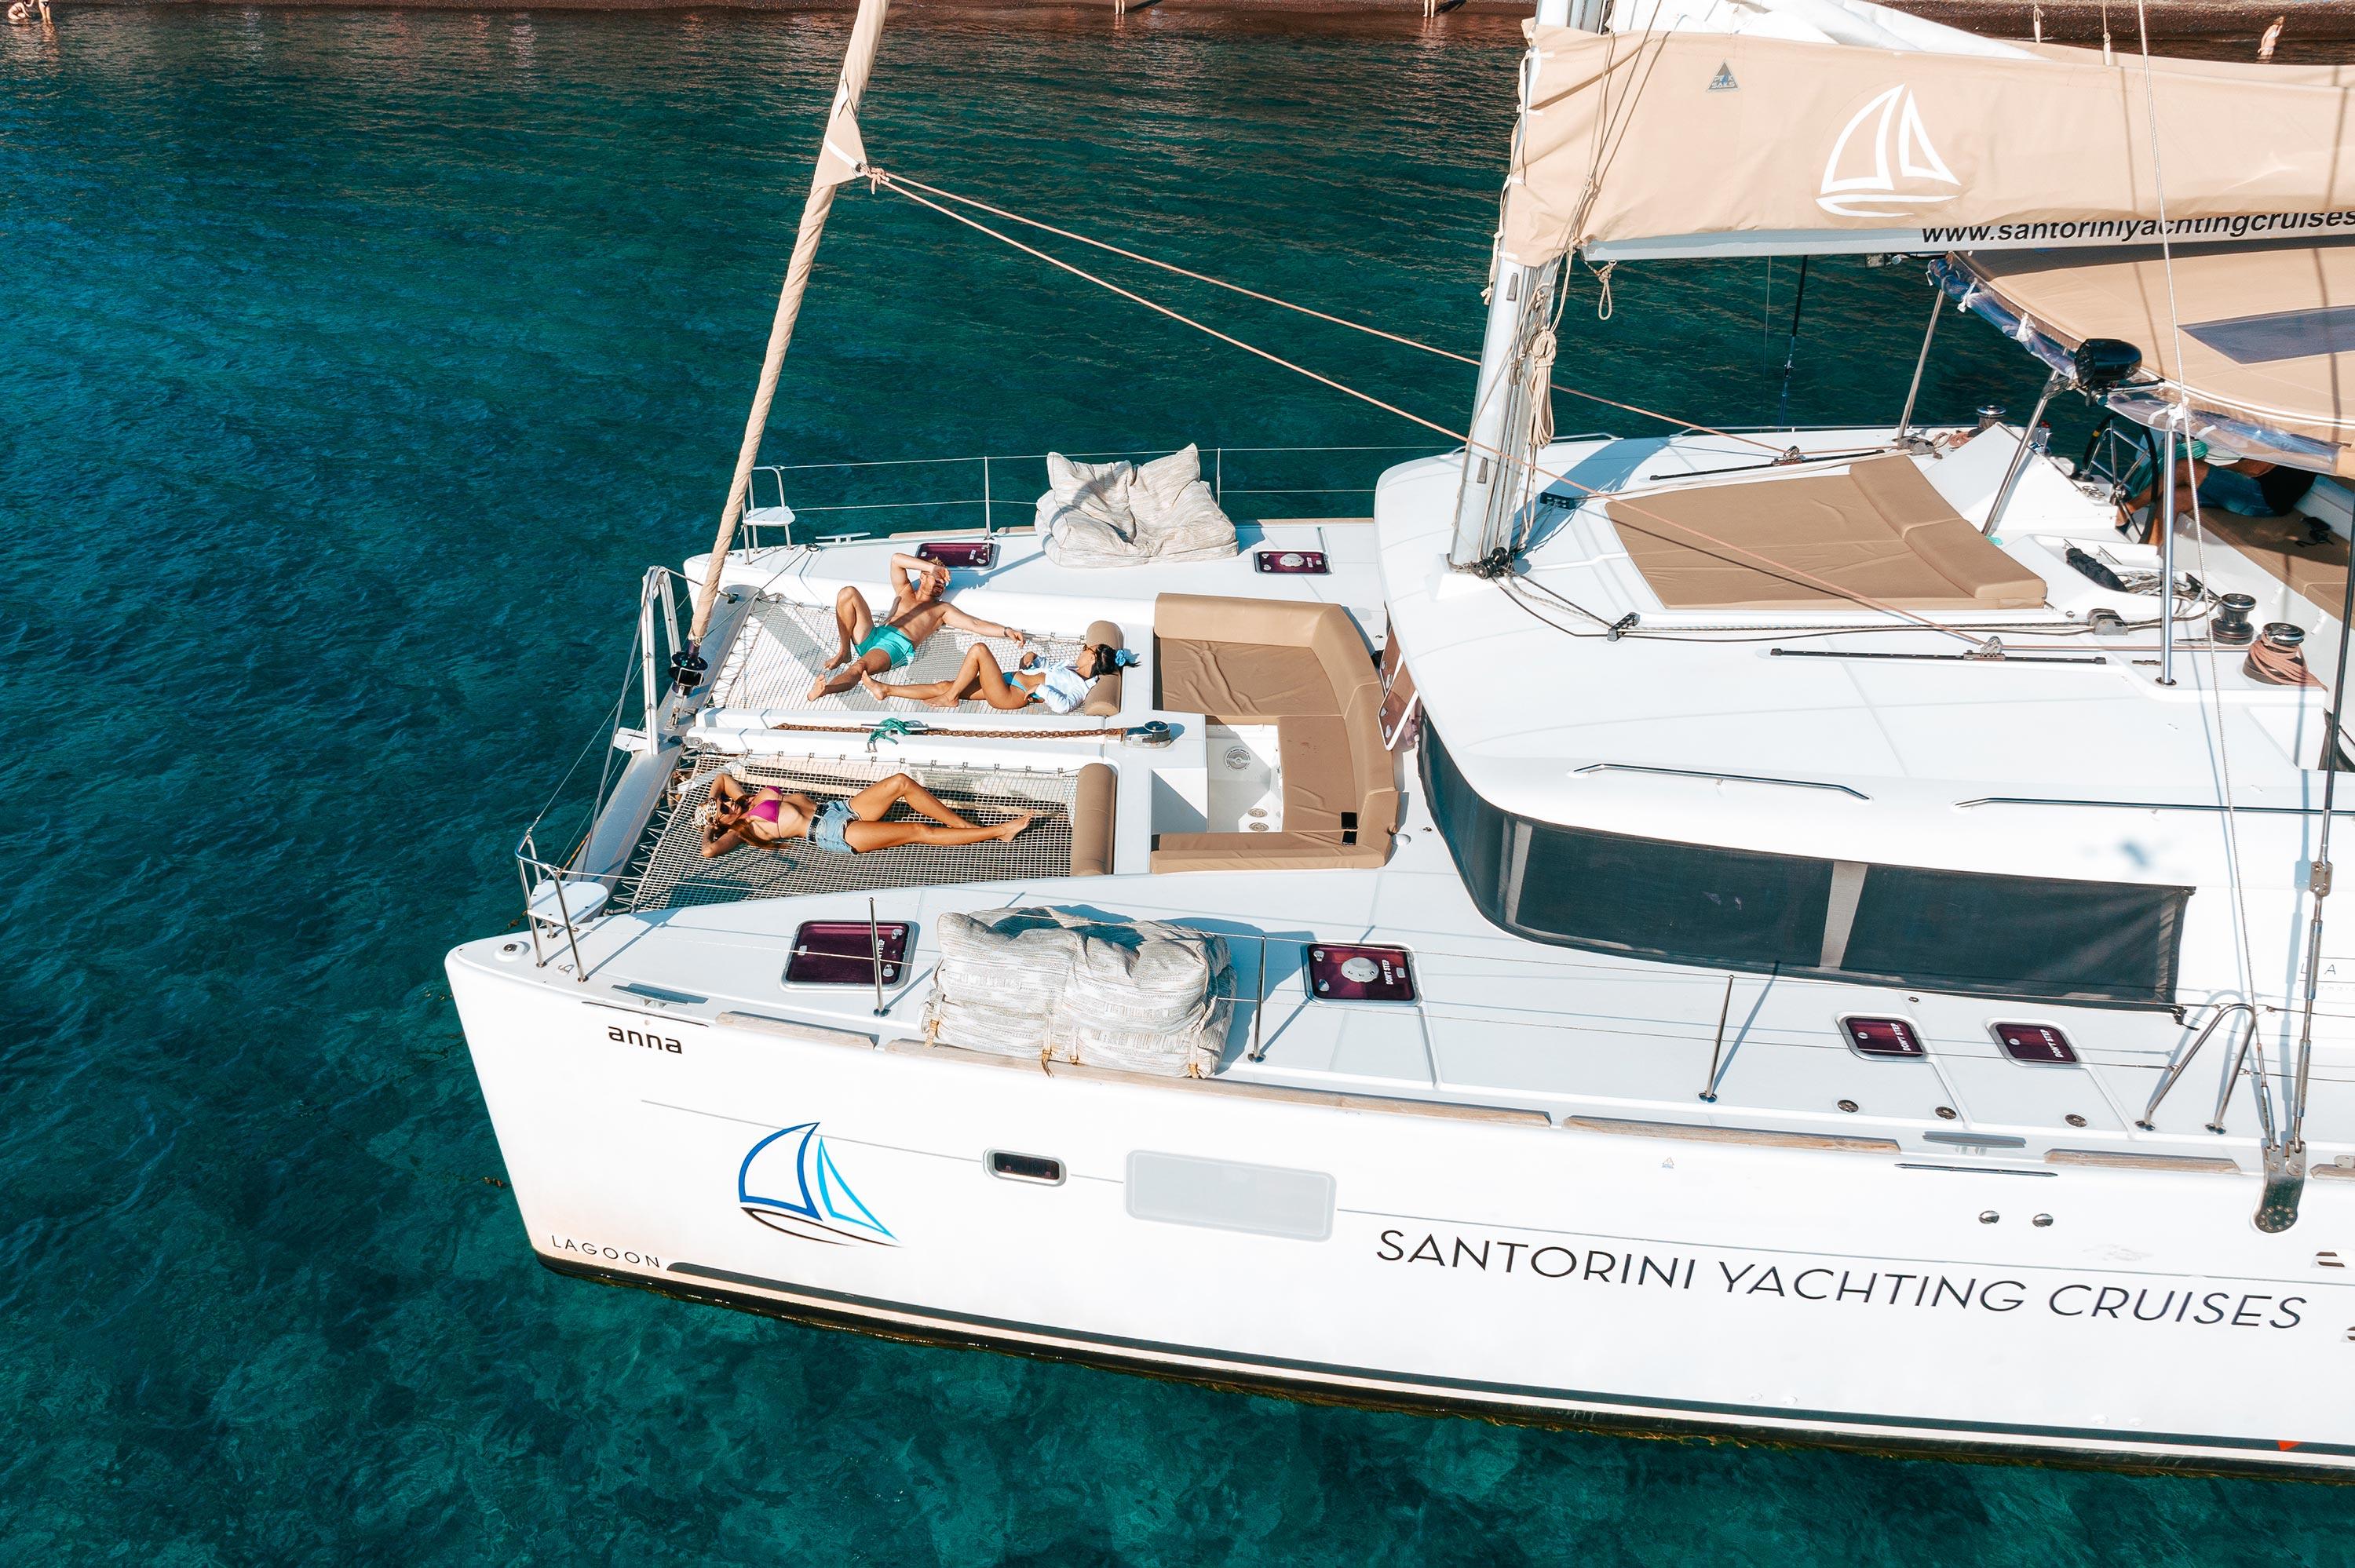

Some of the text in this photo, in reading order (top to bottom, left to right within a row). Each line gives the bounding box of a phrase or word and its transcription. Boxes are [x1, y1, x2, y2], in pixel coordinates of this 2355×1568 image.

[1382, 959, 1391, 971] STEP
[1890, 1023, 1904, 1036] STEP
[2039, 1029, 2054, 1042] STEP
[608, 1026, 683, 1055] anna
[551, 1234, 660, 1269] LAGOON
[1376, 1230, 2307, 1329] SANTORINI YACHTING CRUISES
